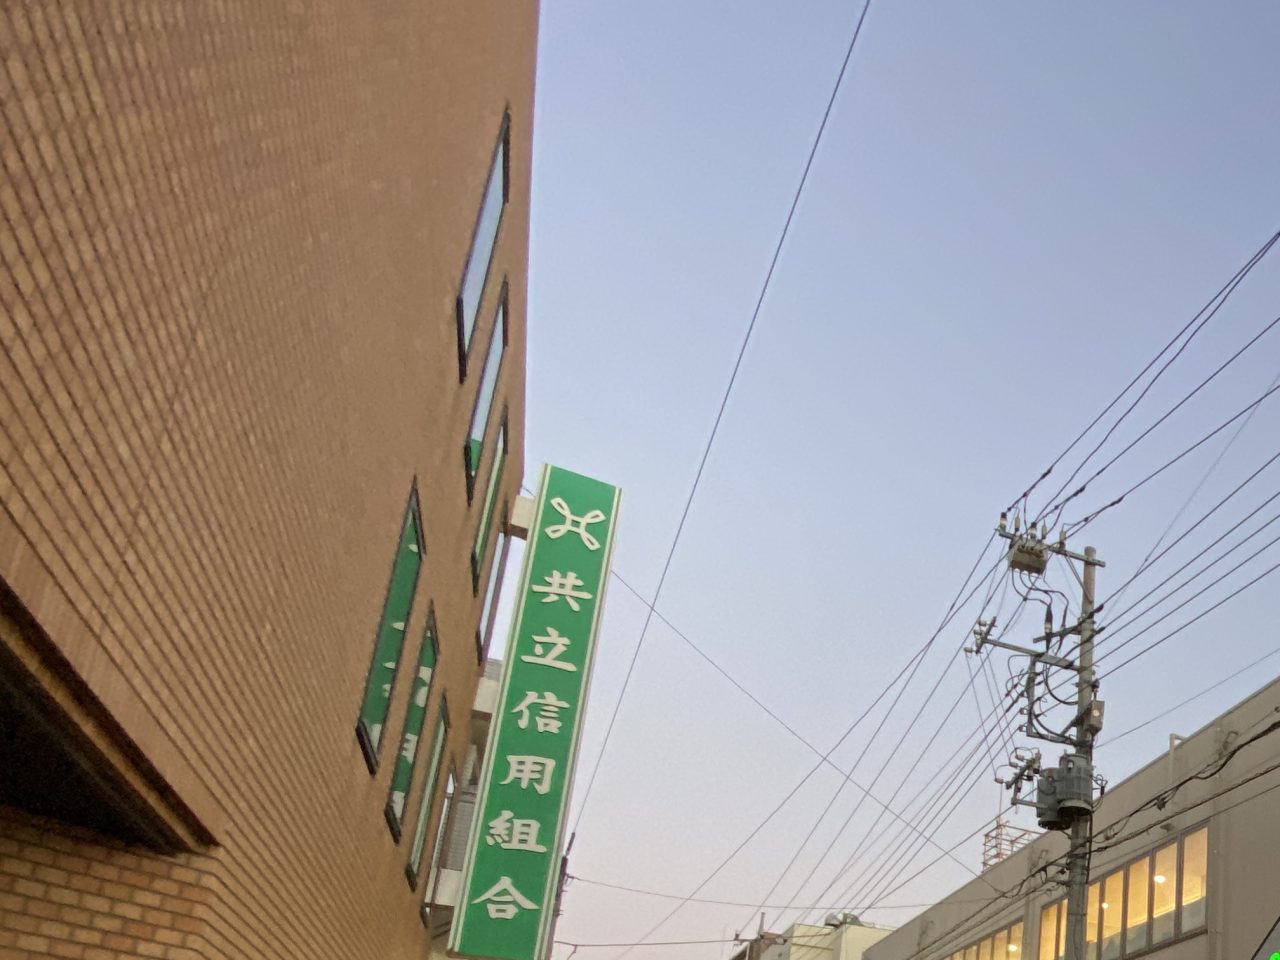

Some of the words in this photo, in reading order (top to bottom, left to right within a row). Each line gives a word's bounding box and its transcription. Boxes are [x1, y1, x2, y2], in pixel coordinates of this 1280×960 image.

[472, 570, 594, 920] 共立信用組合
